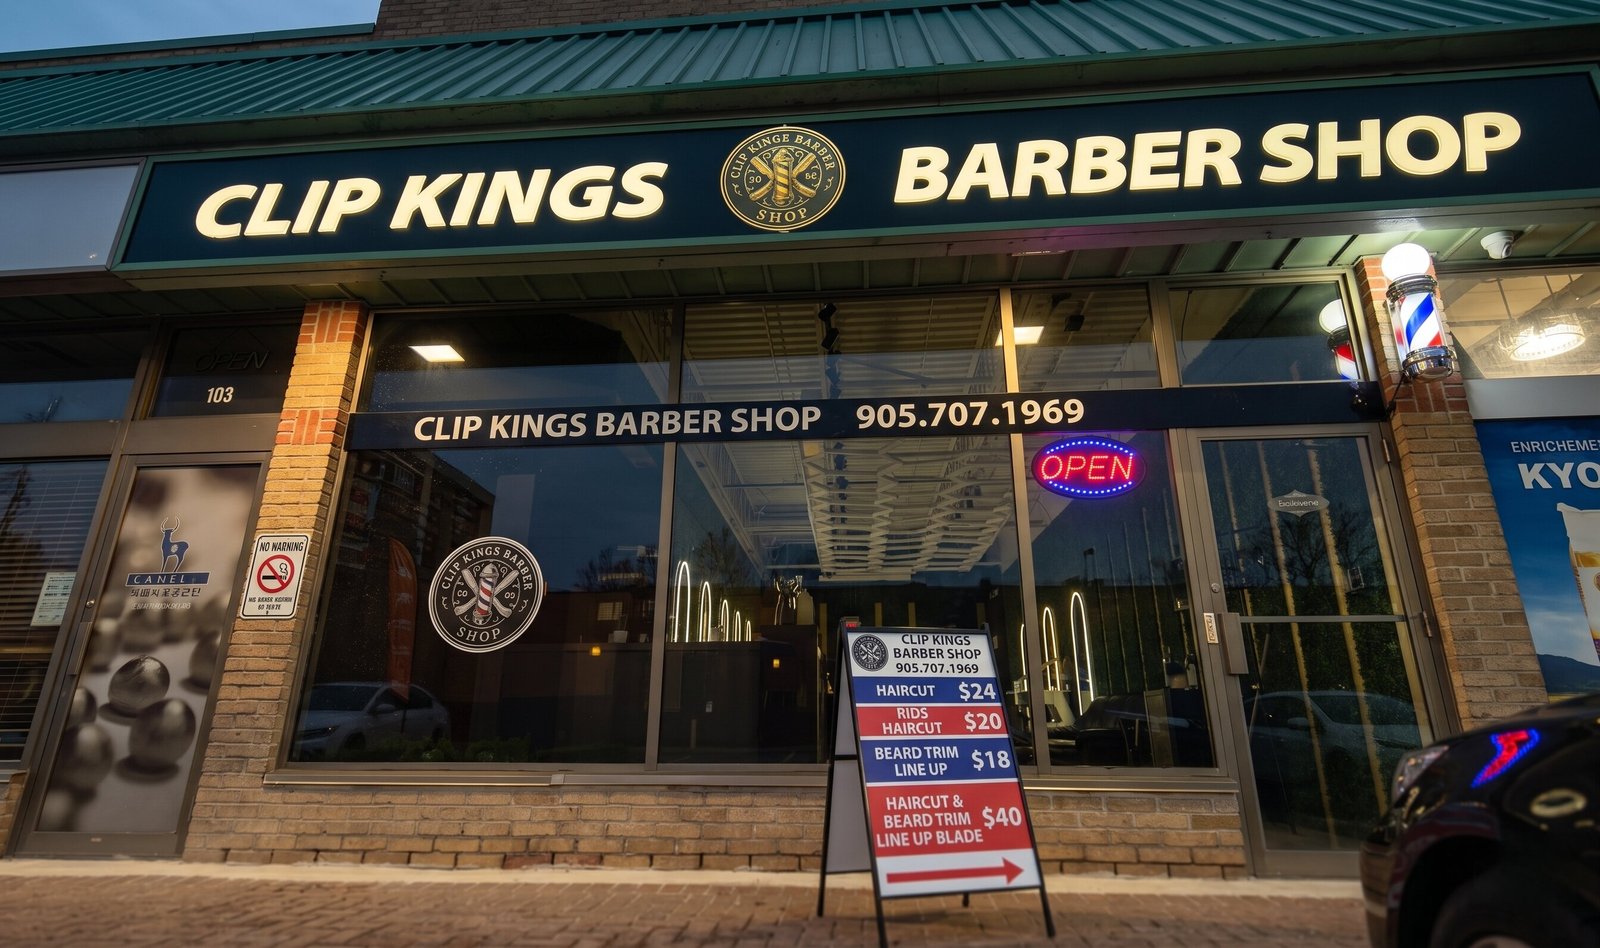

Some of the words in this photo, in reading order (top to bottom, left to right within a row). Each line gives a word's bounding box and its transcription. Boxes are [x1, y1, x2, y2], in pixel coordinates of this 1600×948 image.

[731, 153, 748, 179] CLIP
[747, 134, 790, 154] KINGE
[794, 134, 835, 170] BARBER
[893, 127, 1242, 205] BARBER
[1259, 111, 1522, 184] SHOP
[195, 178, 380, 239] CLIP
[389, 162, 669, 229] KINGS
[756, 207, 808, 223] SHOP
[206, 386, 235, 404] 103
[414, 416, 482, 441] CLIP
[489, 413, 587, 439] KINGS
[595, 409, 722, 437] BARBER
[731, 406, 821, 433] SHOP
[856, 398, 1085, 429] 905.707.1969
[1511, 439, 1600, 453] ENRICHEME
[1041, 455, 1133, 480] OPEN
[1518, 461, 1600, 489] KYO
[259, 541, 270, 552] NO
[271, 541, 304, 552] WARNING
[442, 562, 460, 589] CLIP
[463, 547, 500, 563] KINGS
[503, 549, 533, 591] BARBER
[456, 626, 501, 642] SHOP
[901, 634, 929, 645] CLIP
[932, 635, 971, 646] KINGS
[893, 648, 944, 659] BARBER
[947, 649, 981, 660] SHOP
[896, 663, 979, 674] 905.707.1969
[876, 684, 935, 697] HAIRCUT
[958, 682, 996, 701] $24
[896, 708, 928, 719] RIDS
[882, 722, 942, 735] HAIRCUT
[964, 712, 1002, 732] $20
[874, 747, 922, 760] BEARD
[924, 746, 959, 759] TRIM
[895, 763, 926, 777] LINE
[928, 763, 948, 776] UP
[971, 750, 1011, 771] $18
[886, 796, 949, 811] HAIRCUT
[953, 795, 964, 808] &
[883, 814, 933, 829] BEARD
[935, 812, 971, 826] TRIM
[982, 806, 1022, 829] $40
[876, 832, 909, 848] LINE
[913, 831, 933, 846] UP
[936, 829, 983, 845] BLADE
